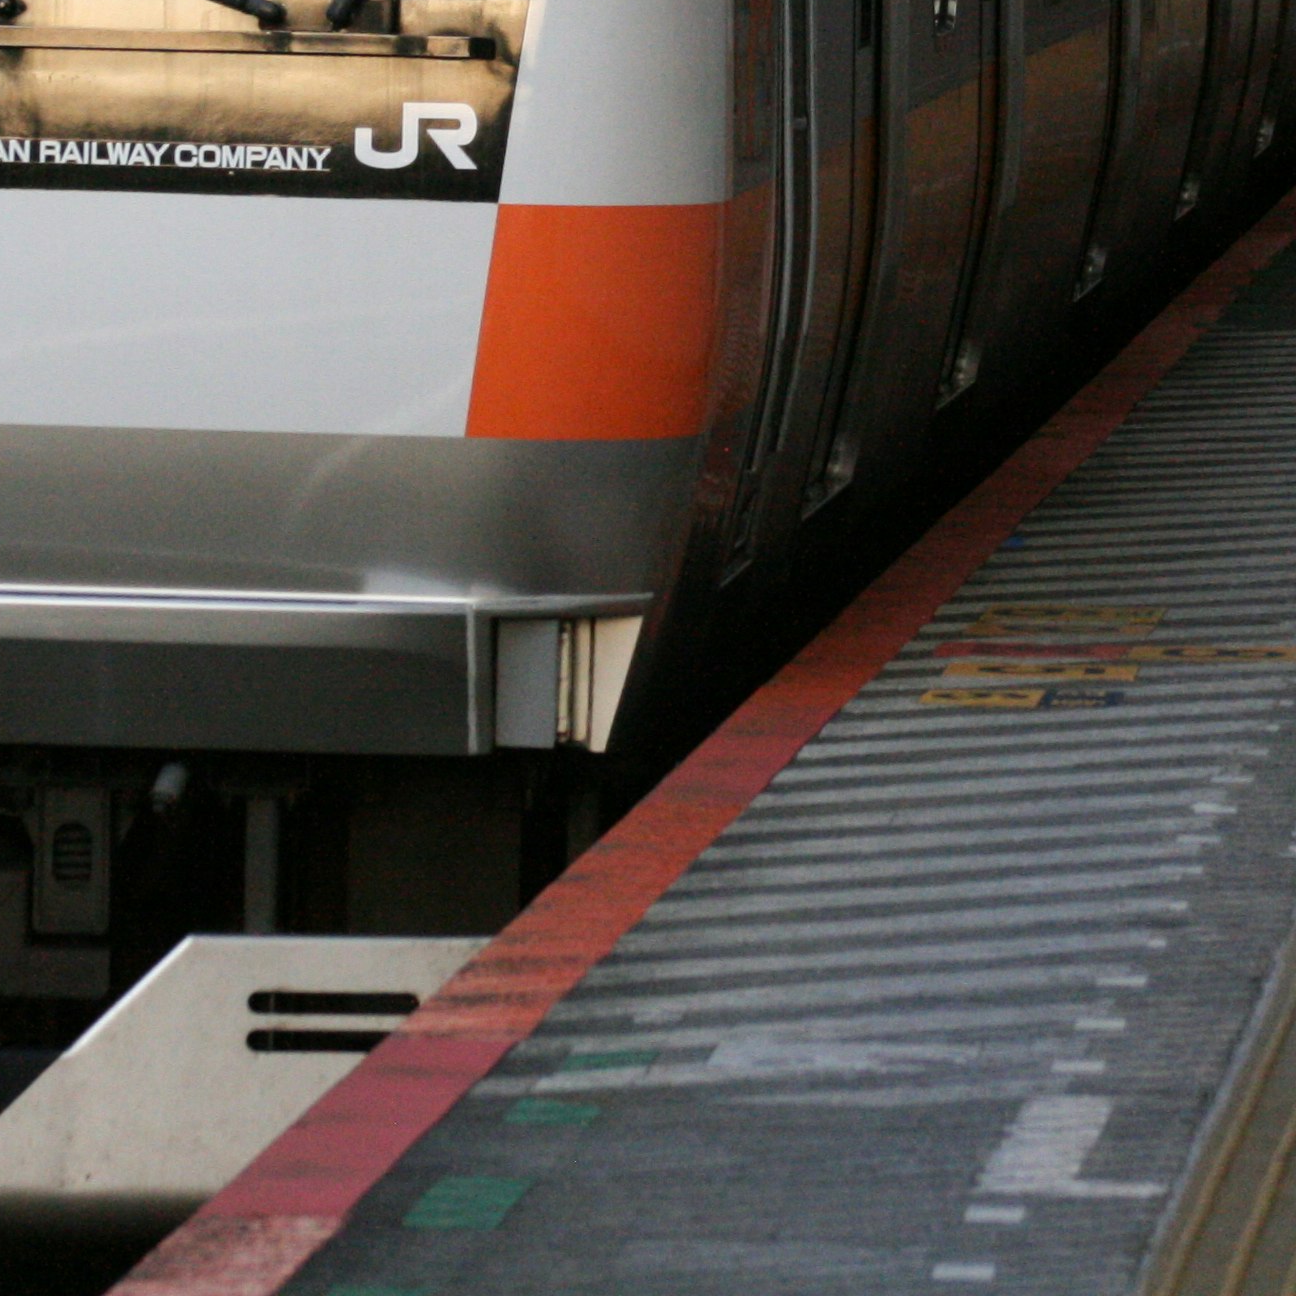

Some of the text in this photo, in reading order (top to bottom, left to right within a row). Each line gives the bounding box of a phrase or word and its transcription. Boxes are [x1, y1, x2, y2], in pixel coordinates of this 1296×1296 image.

[39, 139, 170, 166] RAILWAY
[174, 143, 331, 171] COMPANY
[355, 102, 478, 170] JR
